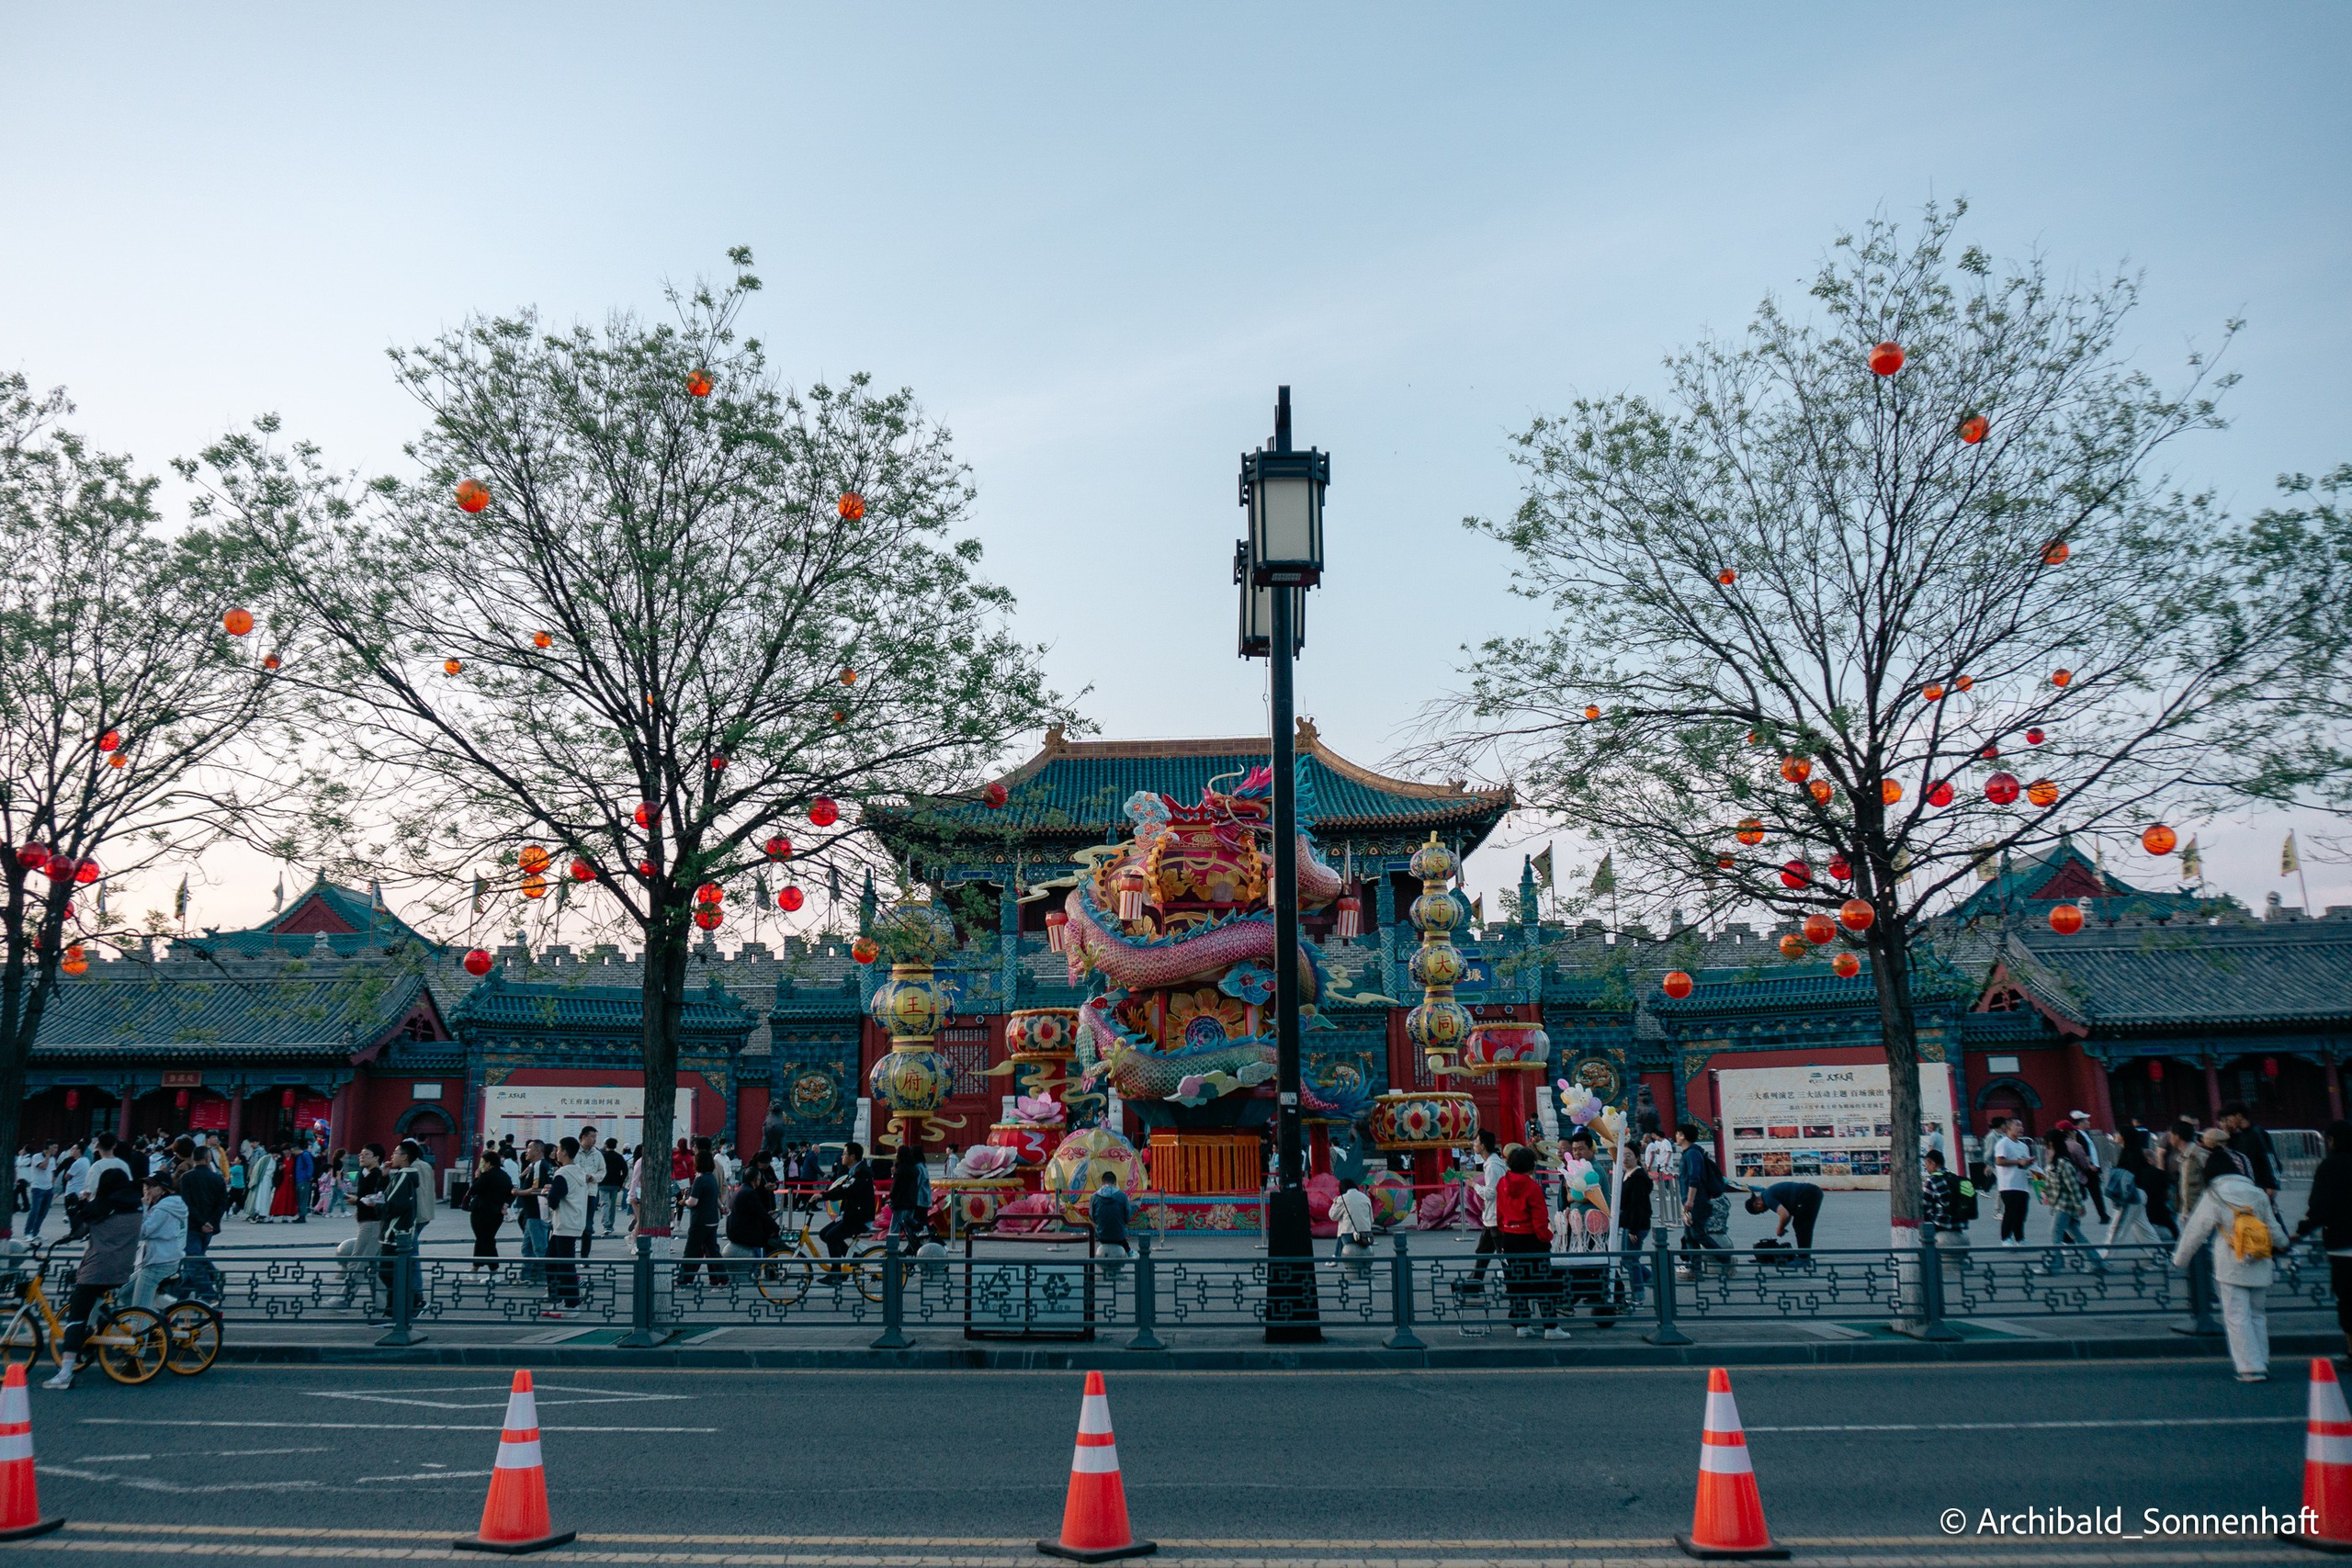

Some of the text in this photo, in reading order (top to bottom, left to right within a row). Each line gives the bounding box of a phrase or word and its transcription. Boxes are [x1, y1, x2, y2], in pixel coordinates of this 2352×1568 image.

[560, 1098, 621, 1106] 代王府演出时间表
